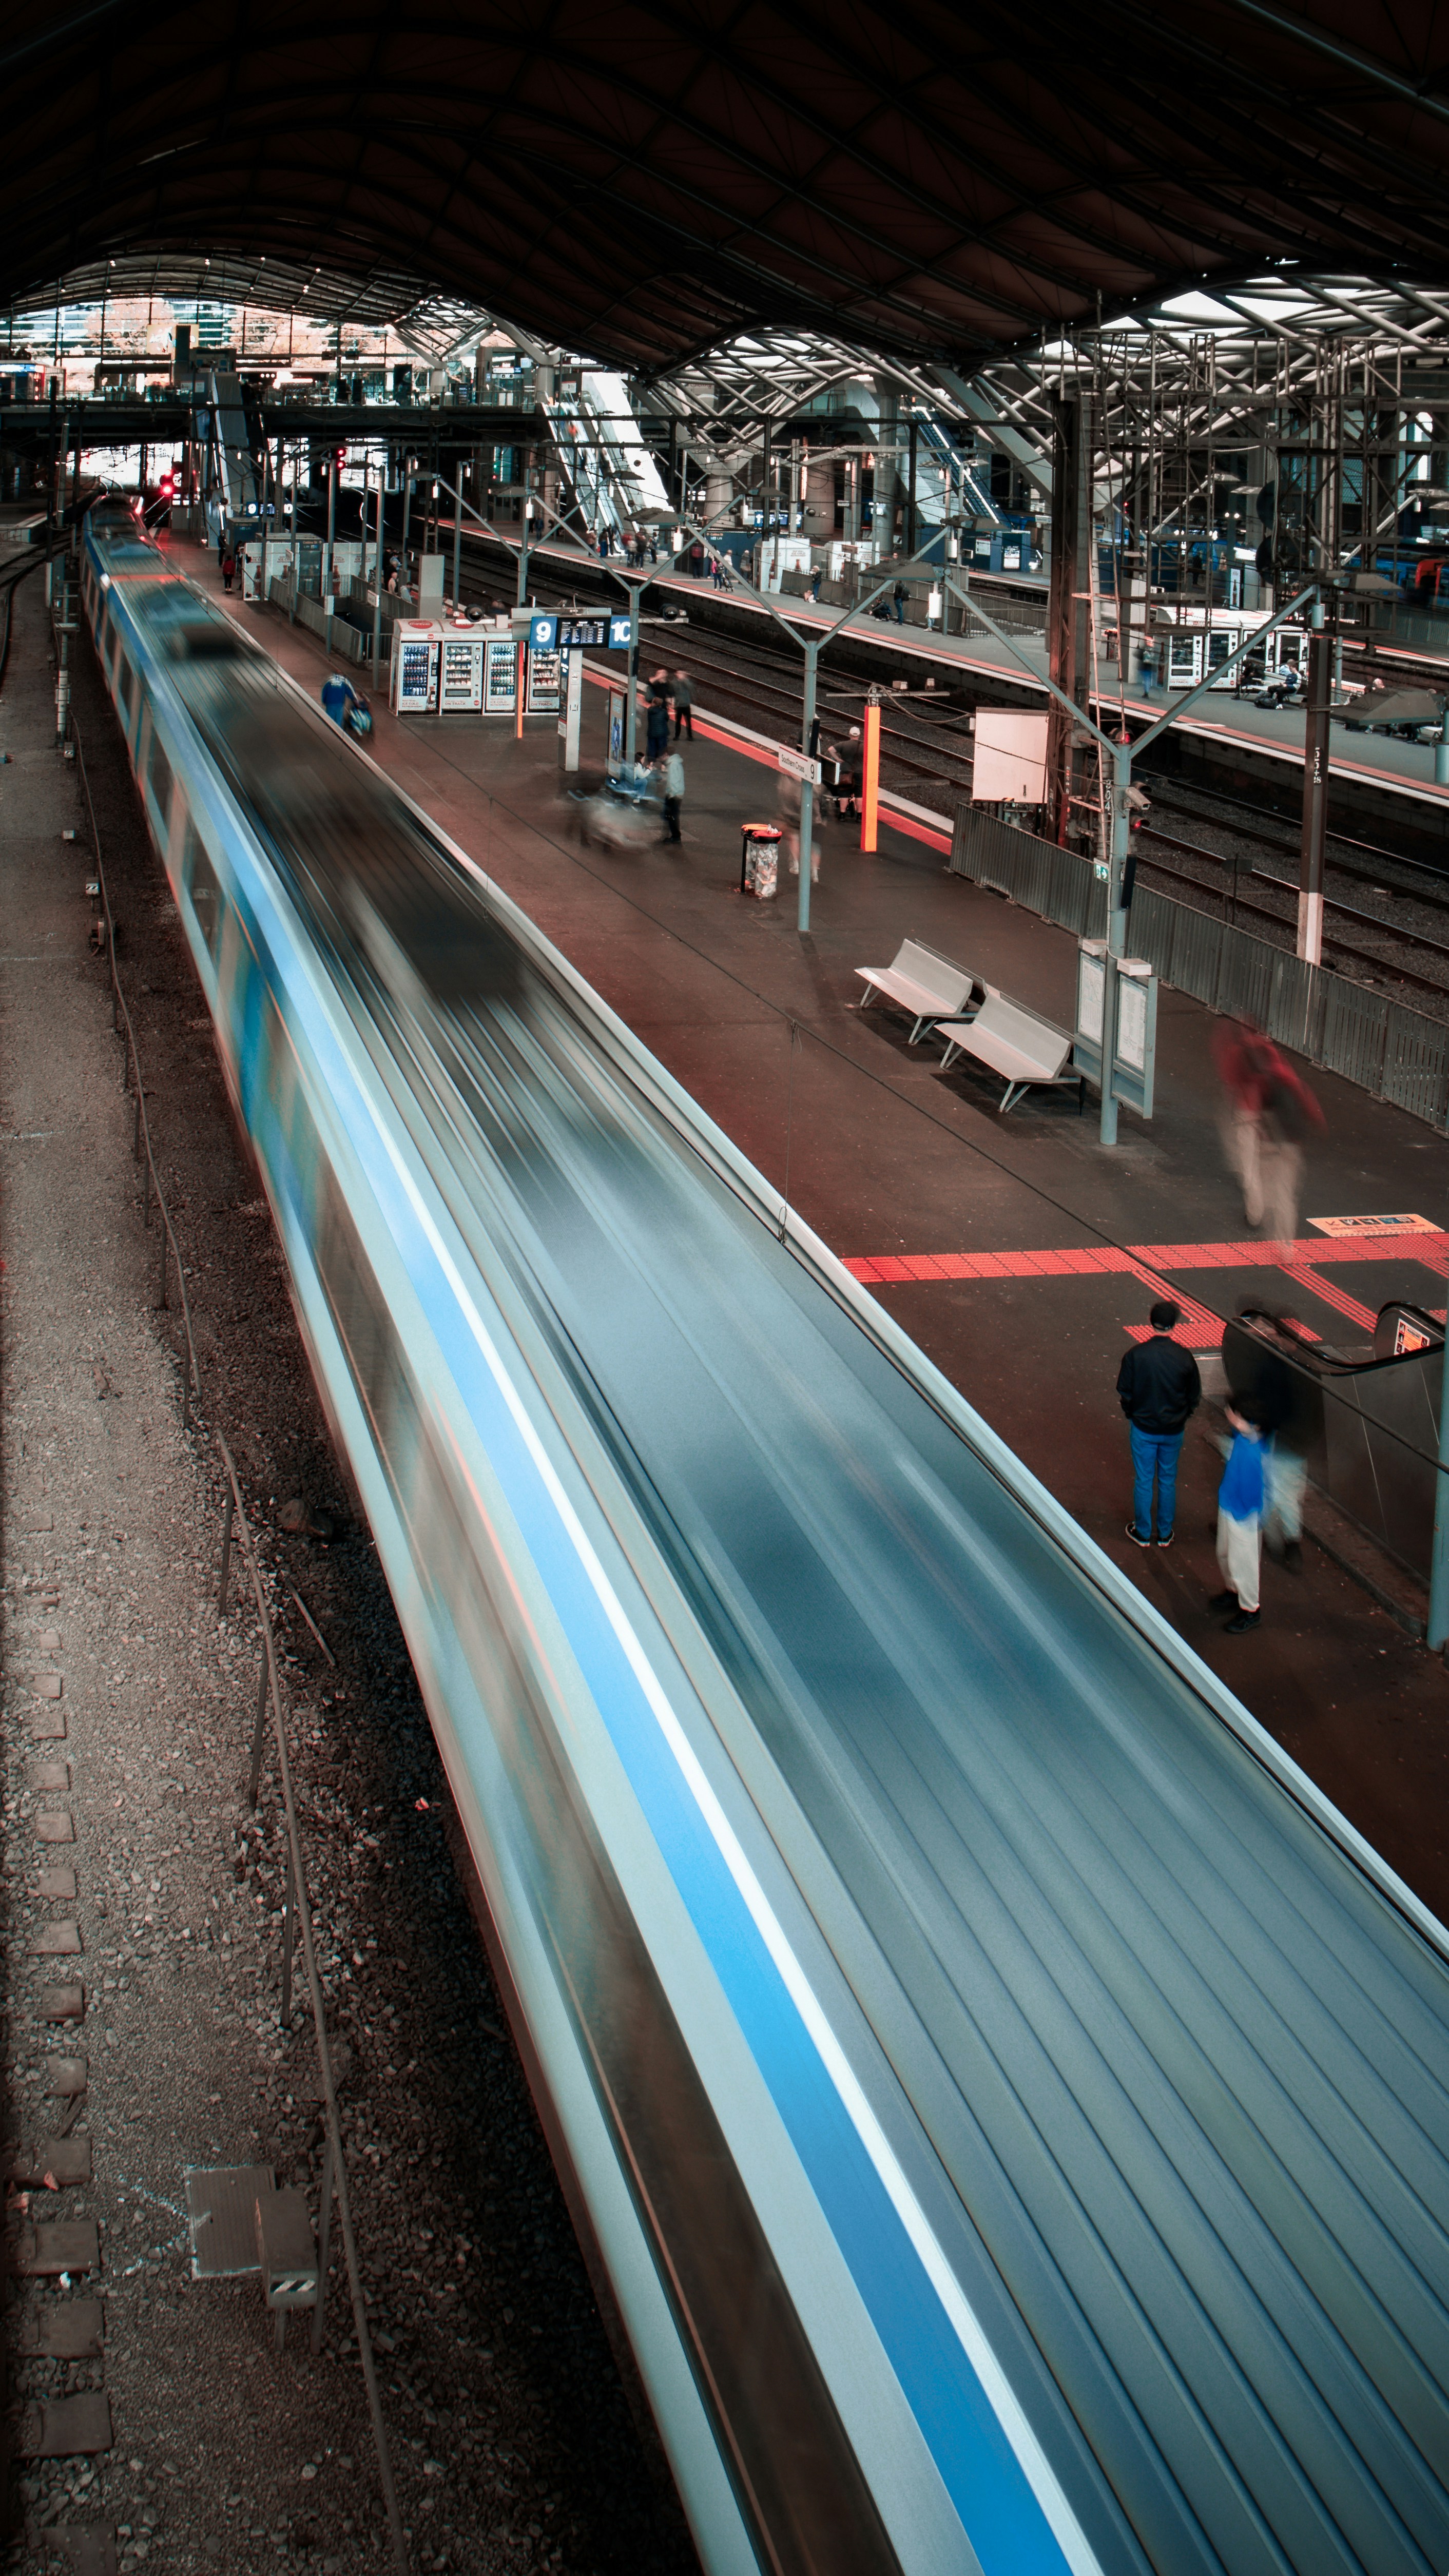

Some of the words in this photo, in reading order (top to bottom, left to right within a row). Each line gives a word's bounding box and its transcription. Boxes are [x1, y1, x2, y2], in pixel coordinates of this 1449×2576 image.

[248, 503, 256, 514] 9
[536, 622, 551, 642] 9
[781, 754, 796, 768] Southern
[795, 762, 805, 773] Cross
[810, 764, 815, 780] 9
